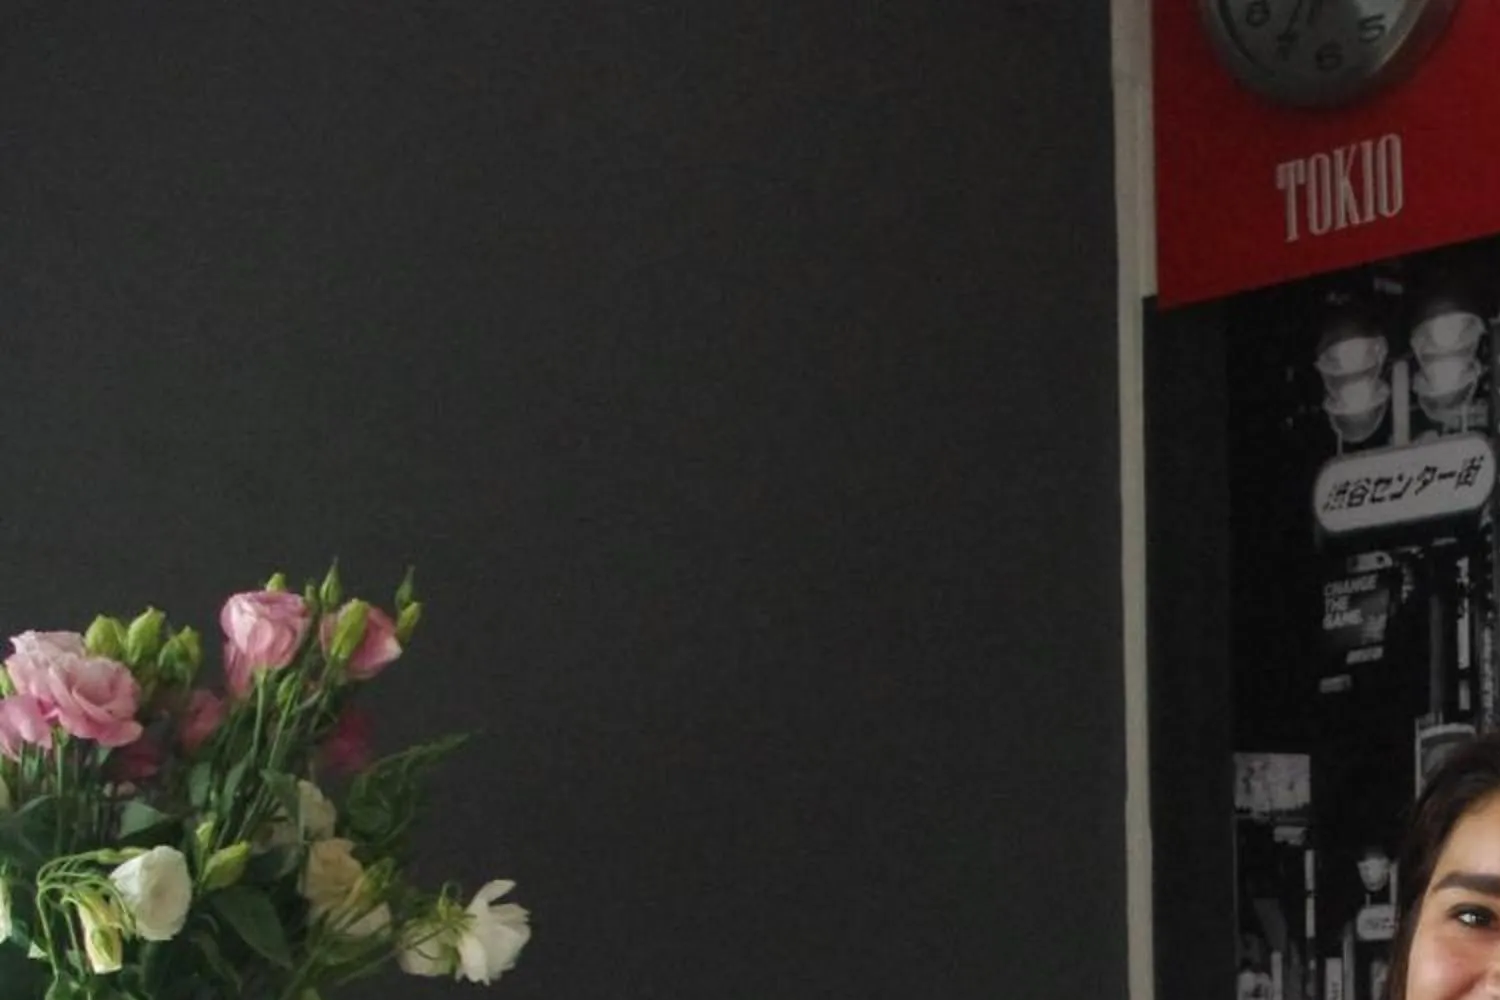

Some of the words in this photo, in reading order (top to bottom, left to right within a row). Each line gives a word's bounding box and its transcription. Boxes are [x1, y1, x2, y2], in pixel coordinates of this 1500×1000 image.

[1358, 13, 1385, 43] 5
[1315, 40, 1344, 73] 6
[1276, 133, 1404, 242] TOKIO
